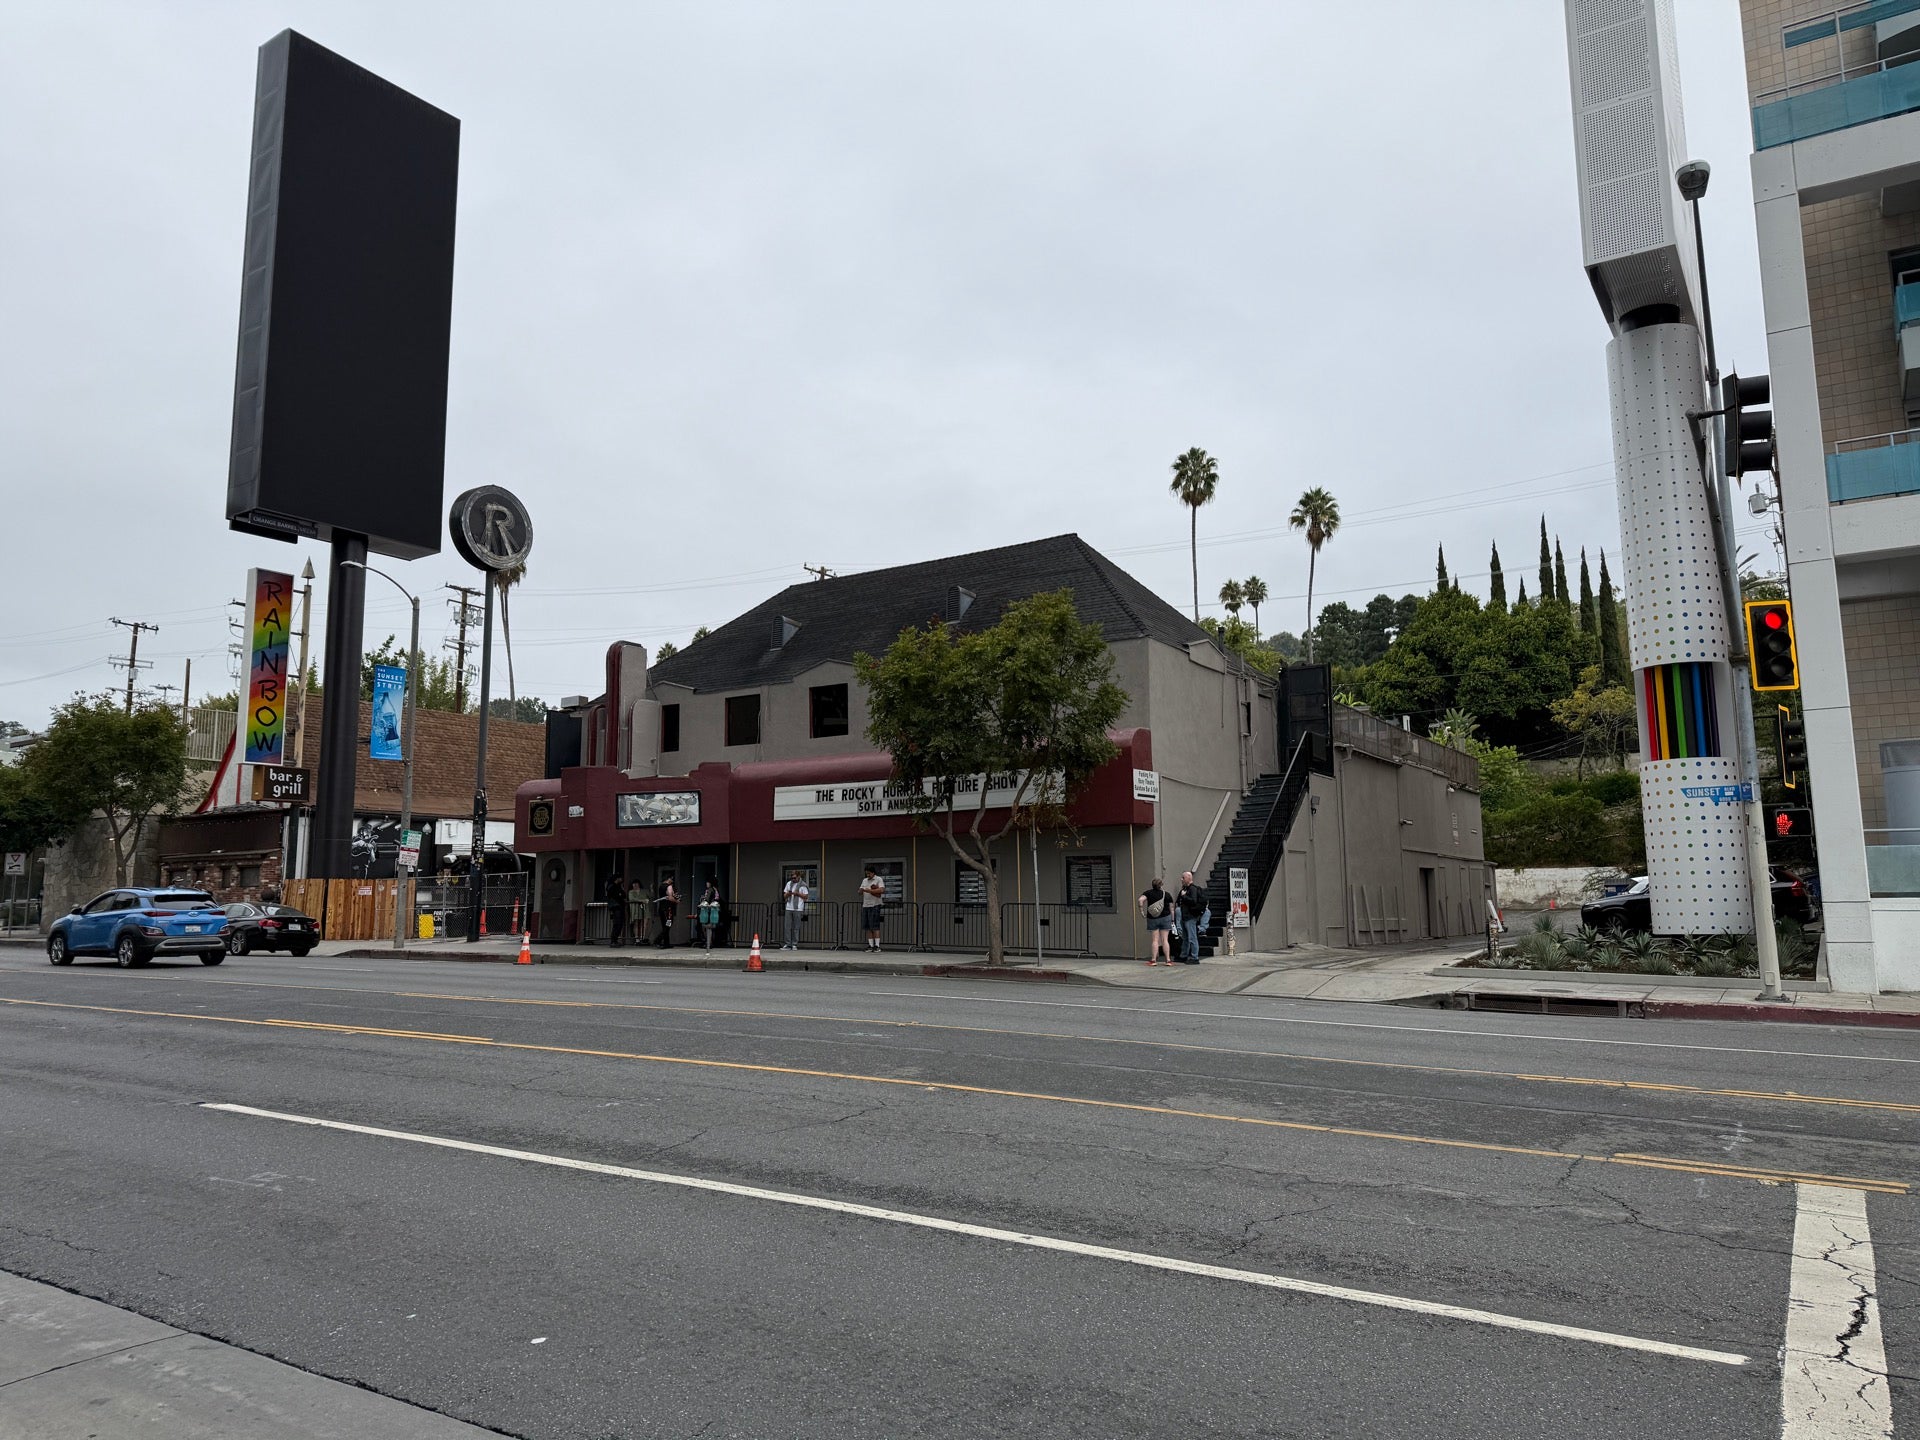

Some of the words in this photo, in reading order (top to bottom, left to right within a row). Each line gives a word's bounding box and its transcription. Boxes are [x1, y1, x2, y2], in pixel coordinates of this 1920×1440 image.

[254, 580, 283, 752] RAINBOW
[377, 672, 403, 681] SUNSET
[377, 681, 402, 690] STRIP
[269, 768, 293, 782] bar
[296, 774, 304, 782] &
[272, 782, 302, 798] grill
[815, 789, 835, 802] THE
[841, 786, 876, 801] ROCKY
[932, 778, 979, 795] PIURE
[1686, 787, 1721, 798] SUNSET
[1230, 870, 1247, 880] RAINBOW
[1234, 880, 1244, 890] ROXY
[1231, 890, 1247, 899] PARKING
